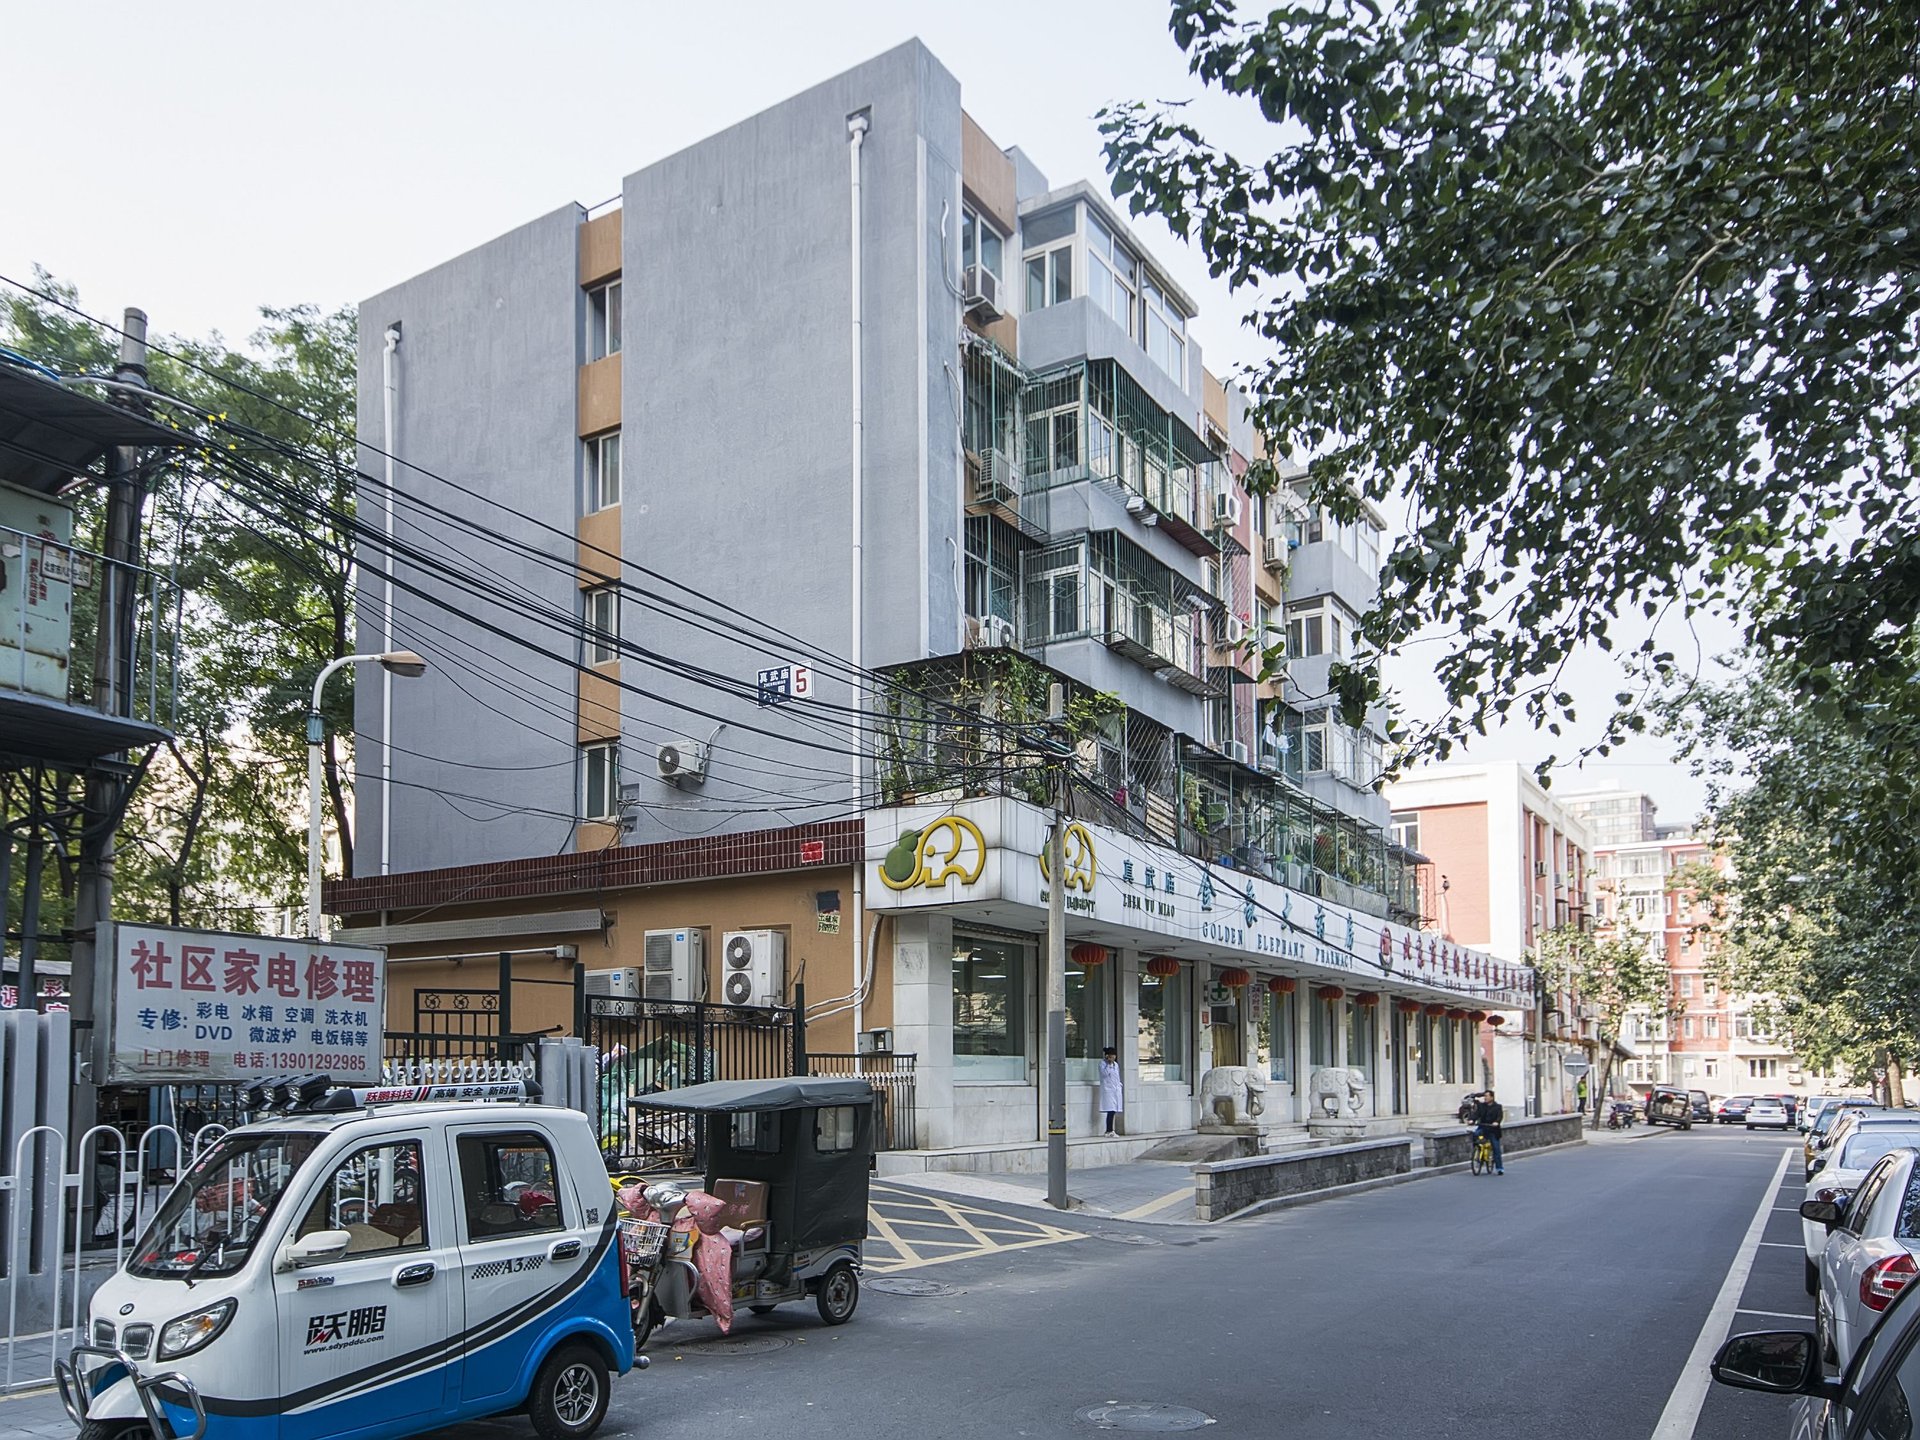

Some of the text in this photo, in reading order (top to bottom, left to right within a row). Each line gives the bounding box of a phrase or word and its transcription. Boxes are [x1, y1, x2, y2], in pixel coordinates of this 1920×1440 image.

[760, 668, 789, 683] 真武庙
[795, 668, 807, 693] 5
[1123, 859, 1175, 895] 真武庙
[1144, 898, 1155, 914] WU
[1158, 902, 1175, 918] MIAO
[1202, 921, 1243, 946] GOLDEN
[1257, 934, 1305, 959] ELEPHANT
[130, 940, 375, 1003] 社区家电修理
[137, 1008, 188, 1030] 专修:
[196, 1002, 368, 1027] 彩电 冰箱 空调 洗衣机
[195, 1025, 368, 1047] DVD 微波炉 电饭锅等
[138, 1049, 366, 1071] 上门修理 电话:13901292985
[365, 1085, 519, 1102] 跃鹏科技 高端 安全 新时尚
[306, 1305, 387, 1347] 跃鹏
[304, 1335, 384, 1355] www.sdypddc.com
